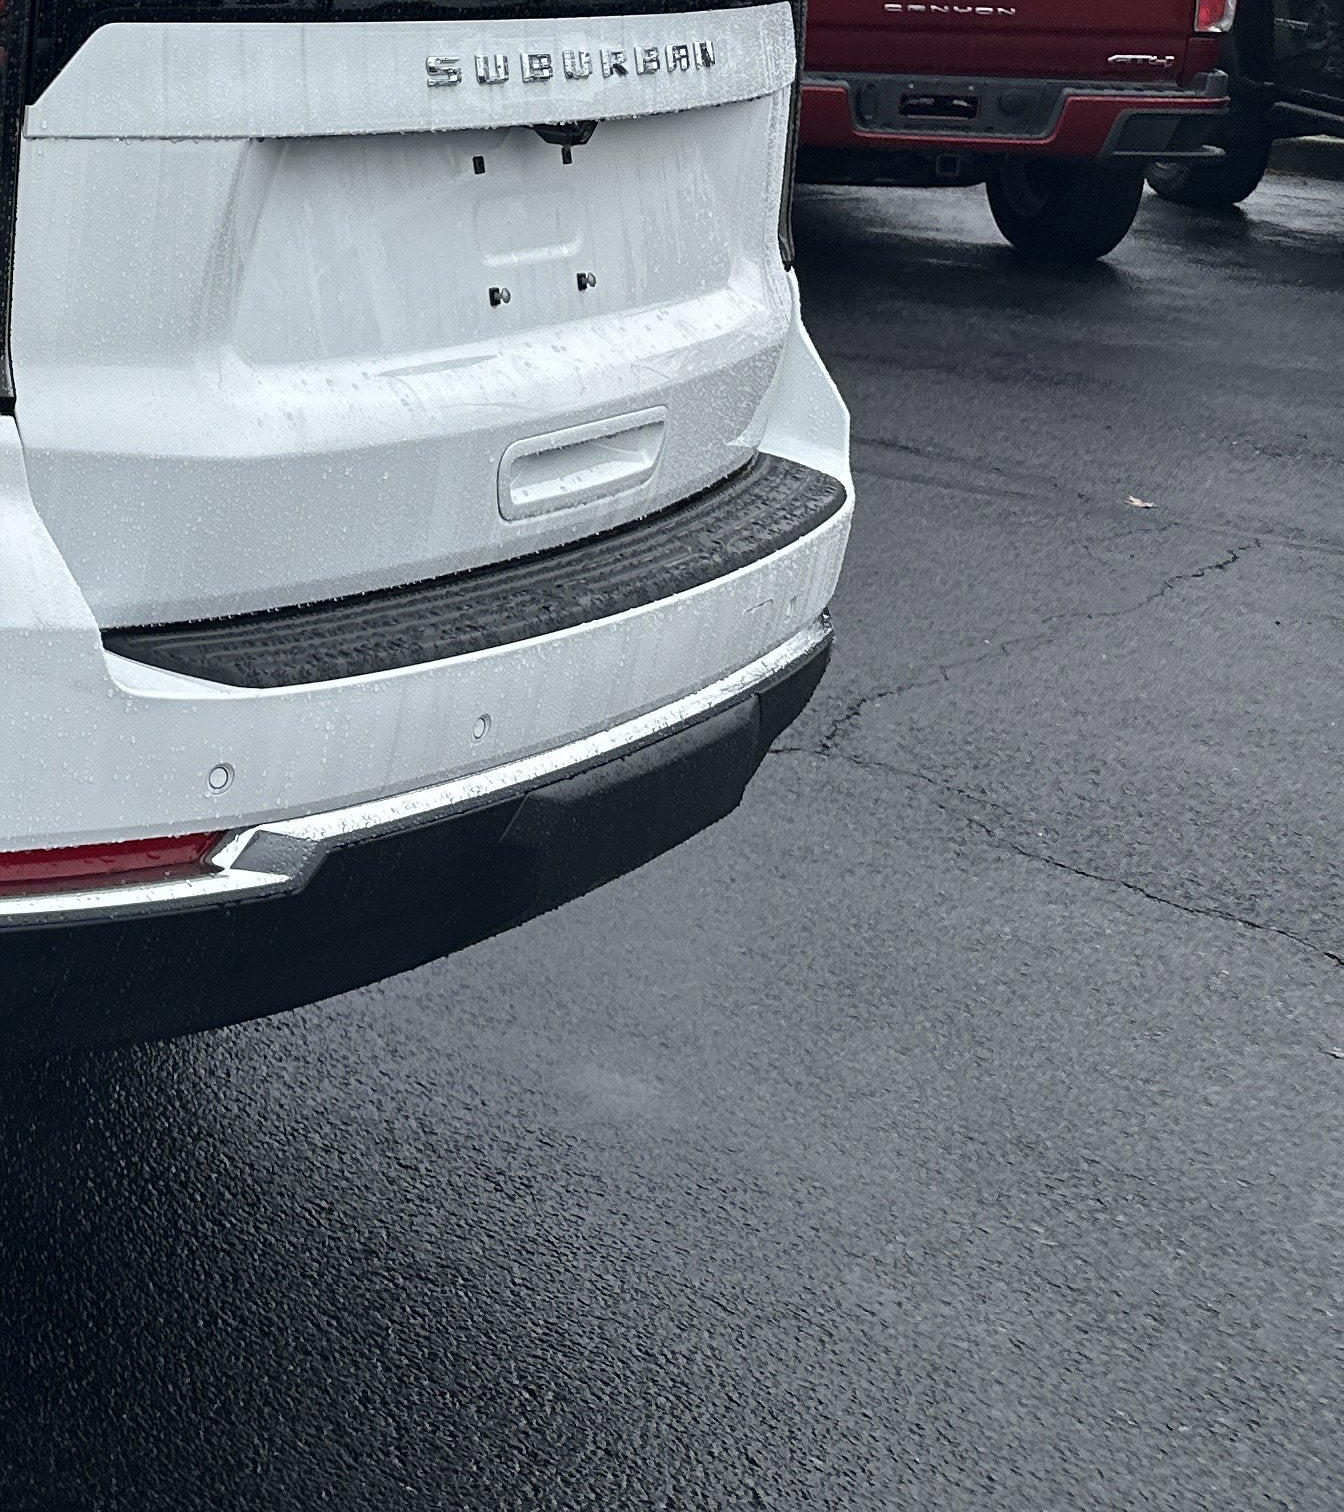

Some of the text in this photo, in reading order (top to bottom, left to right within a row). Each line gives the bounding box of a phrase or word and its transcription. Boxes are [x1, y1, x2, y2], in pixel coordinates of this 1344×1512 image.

[883, 3, 1016, 15] CANYON
[426, 40, 715, 87] SUBURBAN
[1107, 54, 1175, 68] AT4
